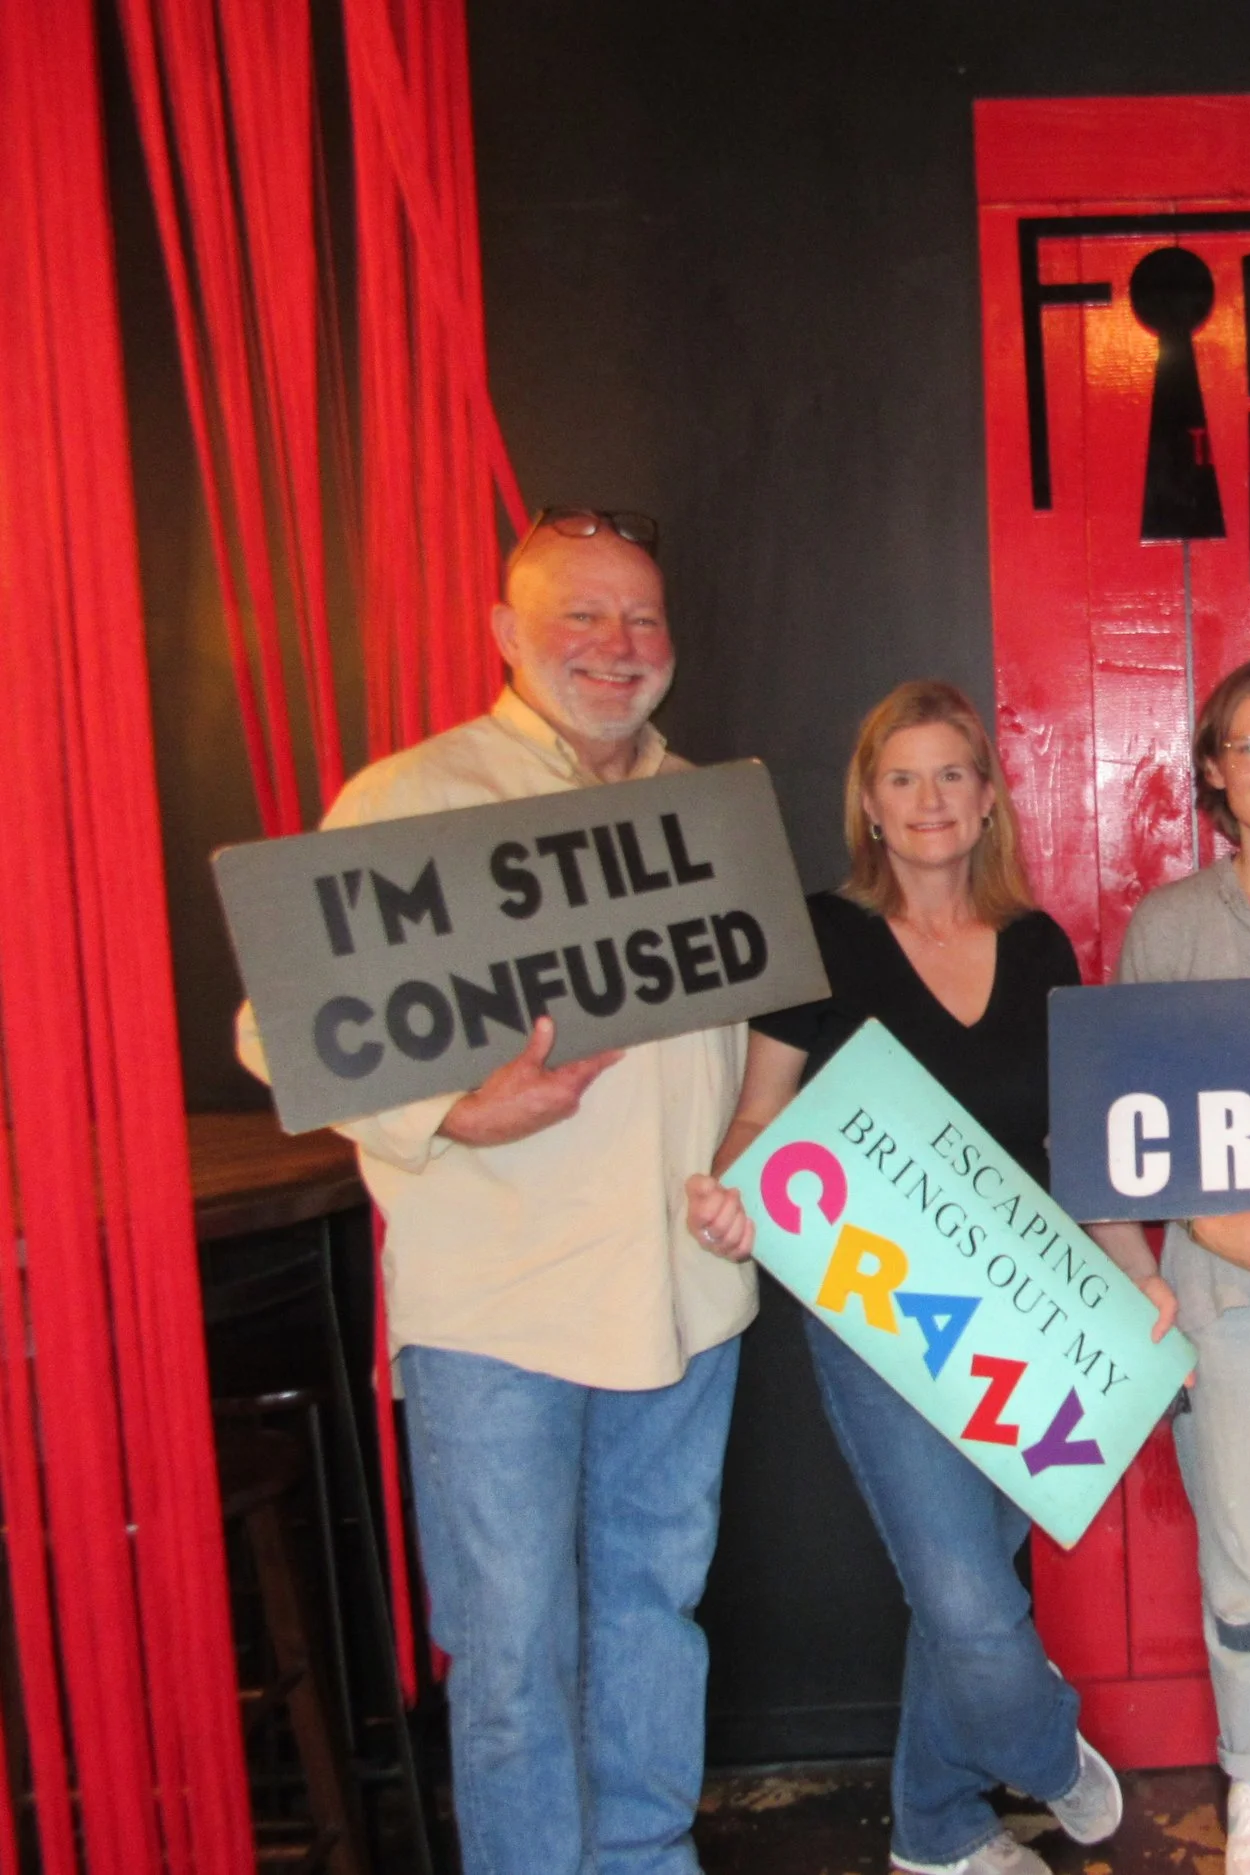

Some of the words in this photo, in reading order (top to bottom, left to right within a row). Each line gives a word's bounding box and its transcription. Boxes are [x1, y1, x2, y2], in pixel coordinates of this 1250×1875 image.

[313, 858, 455, 957] I'M
[489, 812, 716, 920] STILL
[313, 910, 769, 1080] CONFUSED
[760, 1140, 1106, 1477] CRAZY
[838, 1107, 986, 1258] BRINGS
[986, 1252, 1068, 1337] OUT
[1063, 1330, 1130, 1397] MY
[928, 1121, 1110, 1311] ESCAPING
